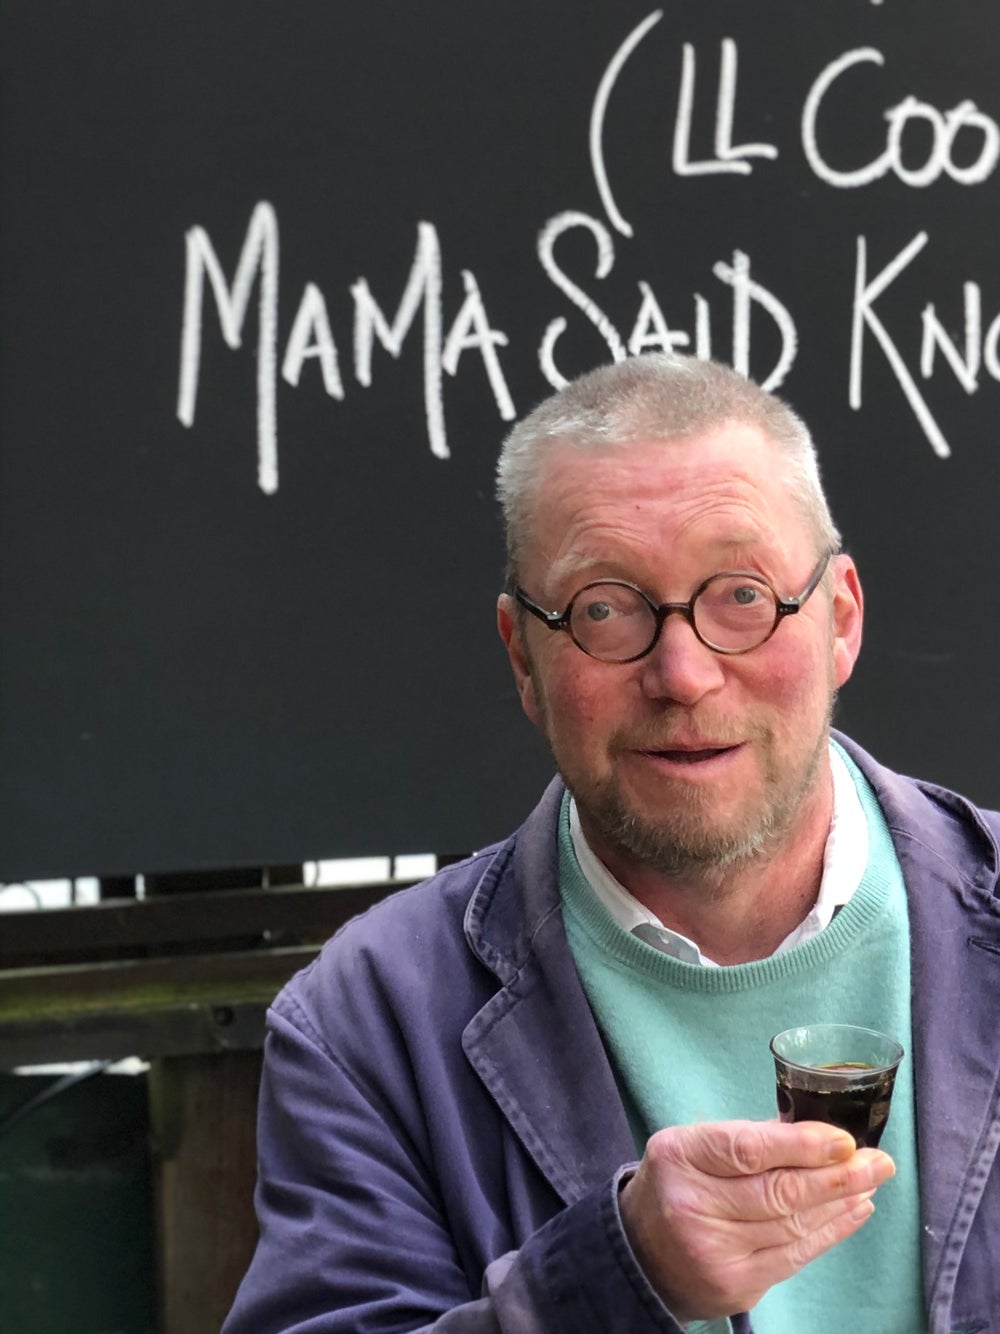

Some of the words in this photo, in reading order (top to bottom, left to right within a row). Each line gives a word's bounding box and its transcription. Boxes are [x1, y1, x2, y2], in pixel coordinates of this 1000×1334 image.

[588, 11, 779, 238] (LL
[176, 201, 518, 494] MAMA
[537, 211, 799, 394] SAID
